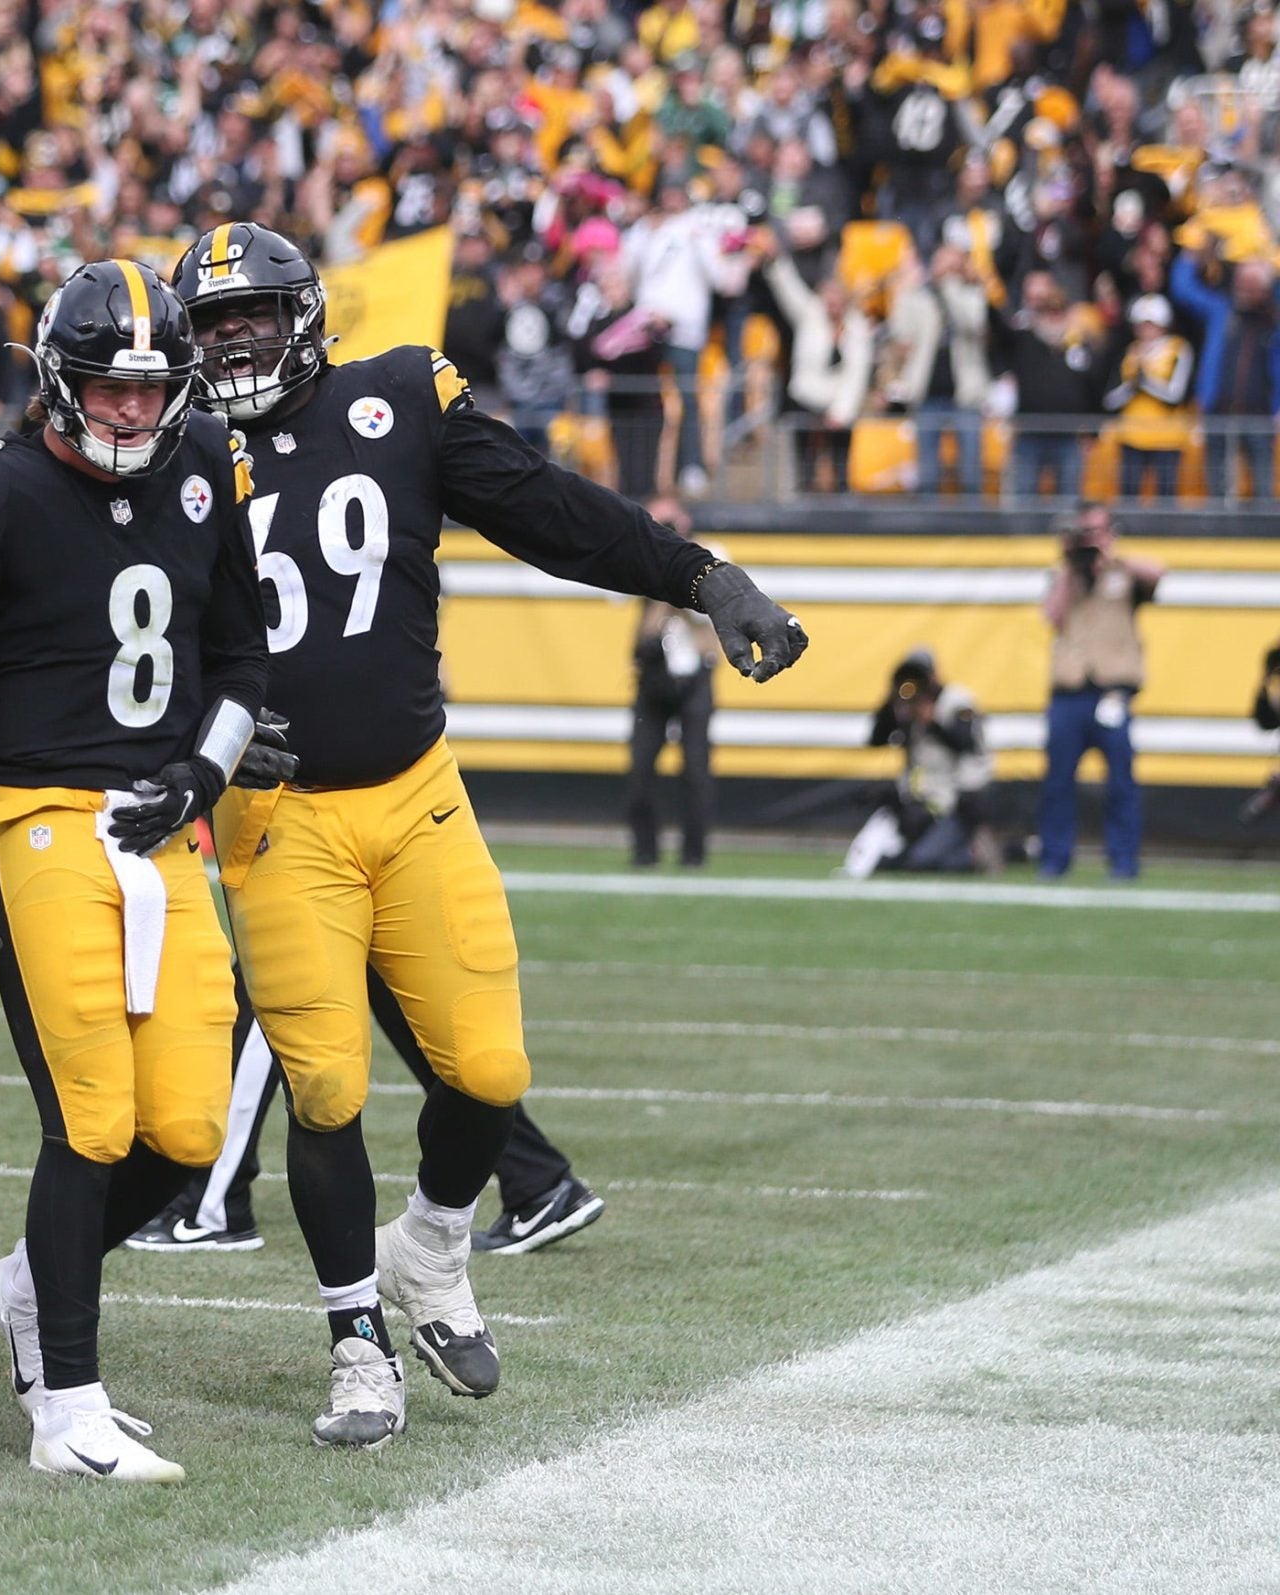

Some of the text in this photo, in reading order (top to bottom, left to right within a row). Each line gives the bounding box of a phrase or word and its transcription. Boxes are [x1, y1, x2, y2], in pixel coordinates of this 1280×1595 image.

[197, 244, 243, 281] 69
[208, 277, 235, 288] Steelers
[133, 316, 151, 350] 8
[128, 353, 156, 362] Steelers
[248, 473, 389, 653] 69
[107, 563, 173, 728] 8
